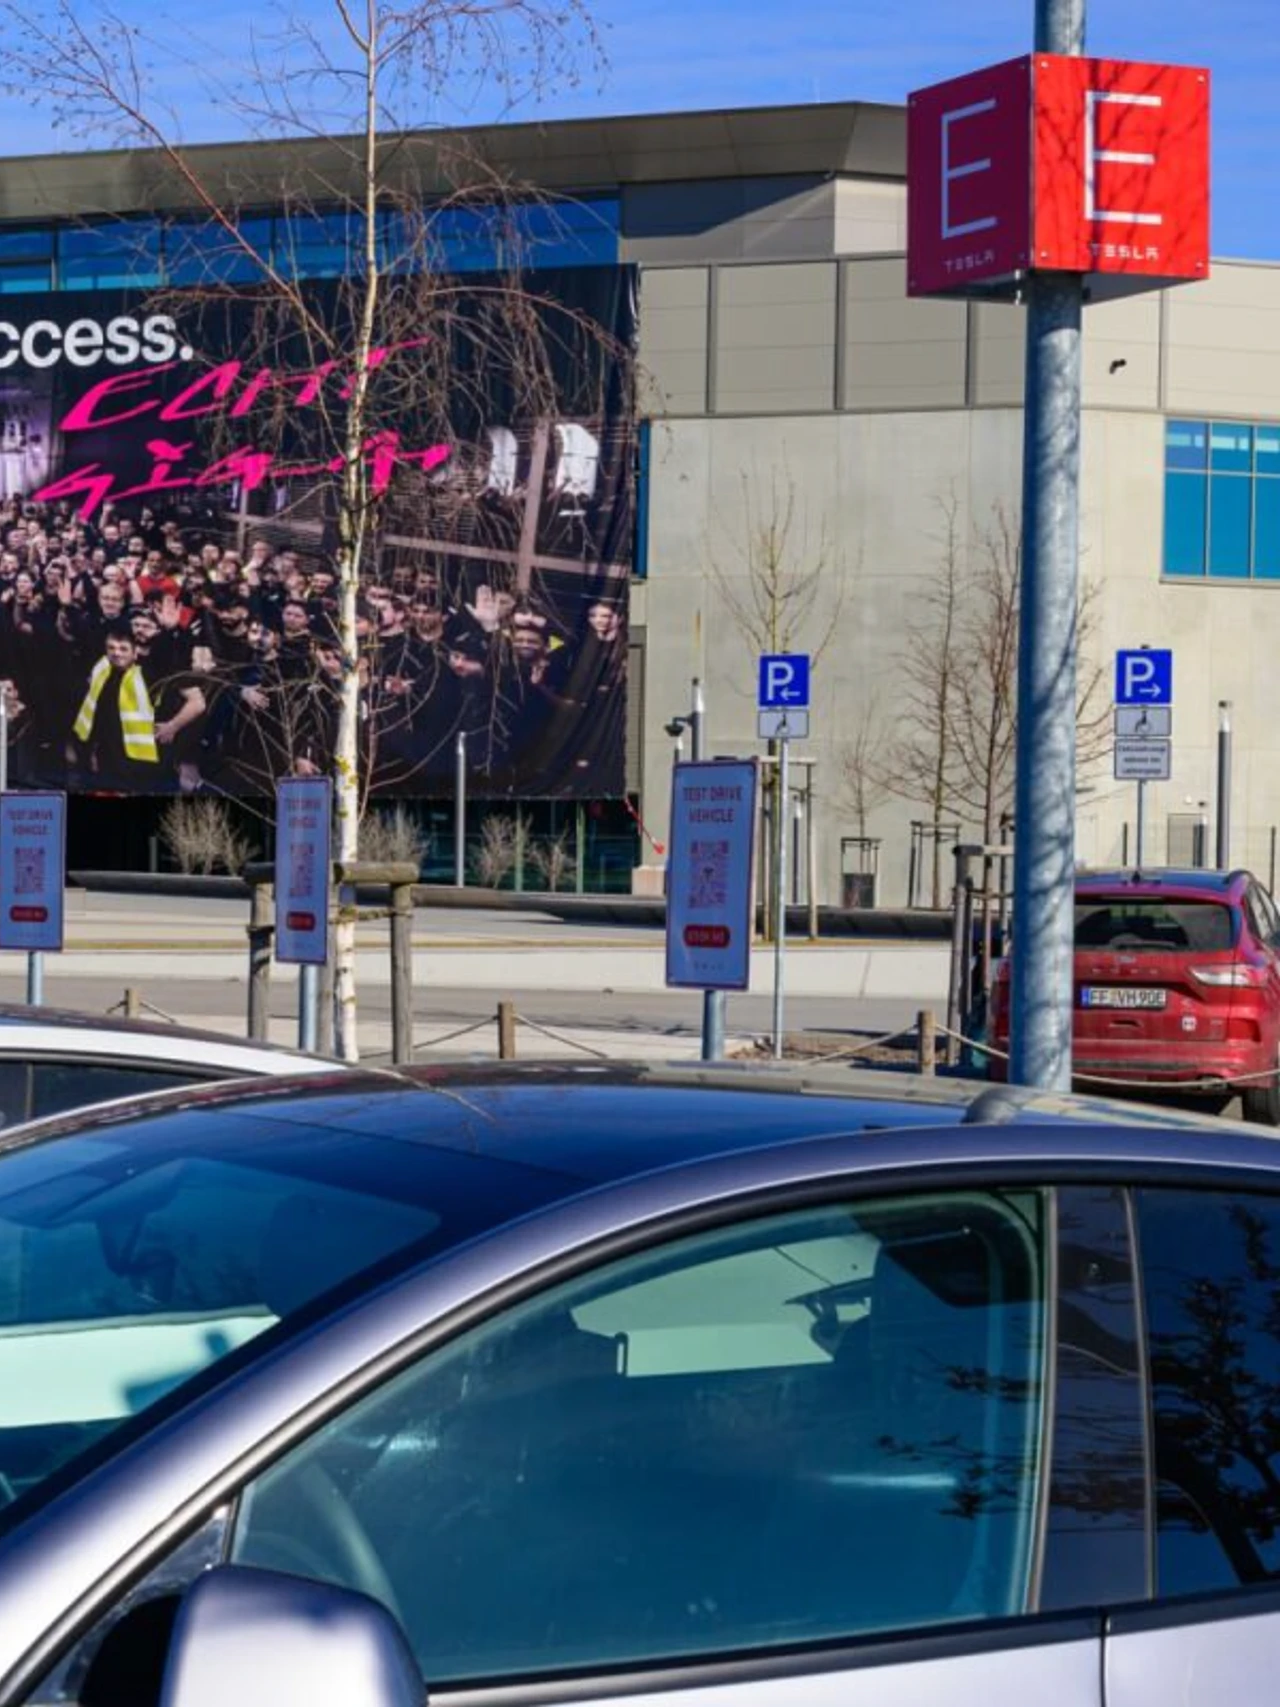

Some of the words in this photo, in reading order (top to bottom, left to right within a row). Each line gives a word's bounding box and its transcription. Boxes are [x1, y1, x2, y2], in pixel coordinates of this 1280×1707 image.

[940, 97, 997, 240] E
[1083, 89, 1162, 225] E
[944, 250, 995, 274] TESLA
[1090, 244, 1160, 261] TESLA
[767, 661, 795, 701] P
[1124, 656, 1155, 698] P
